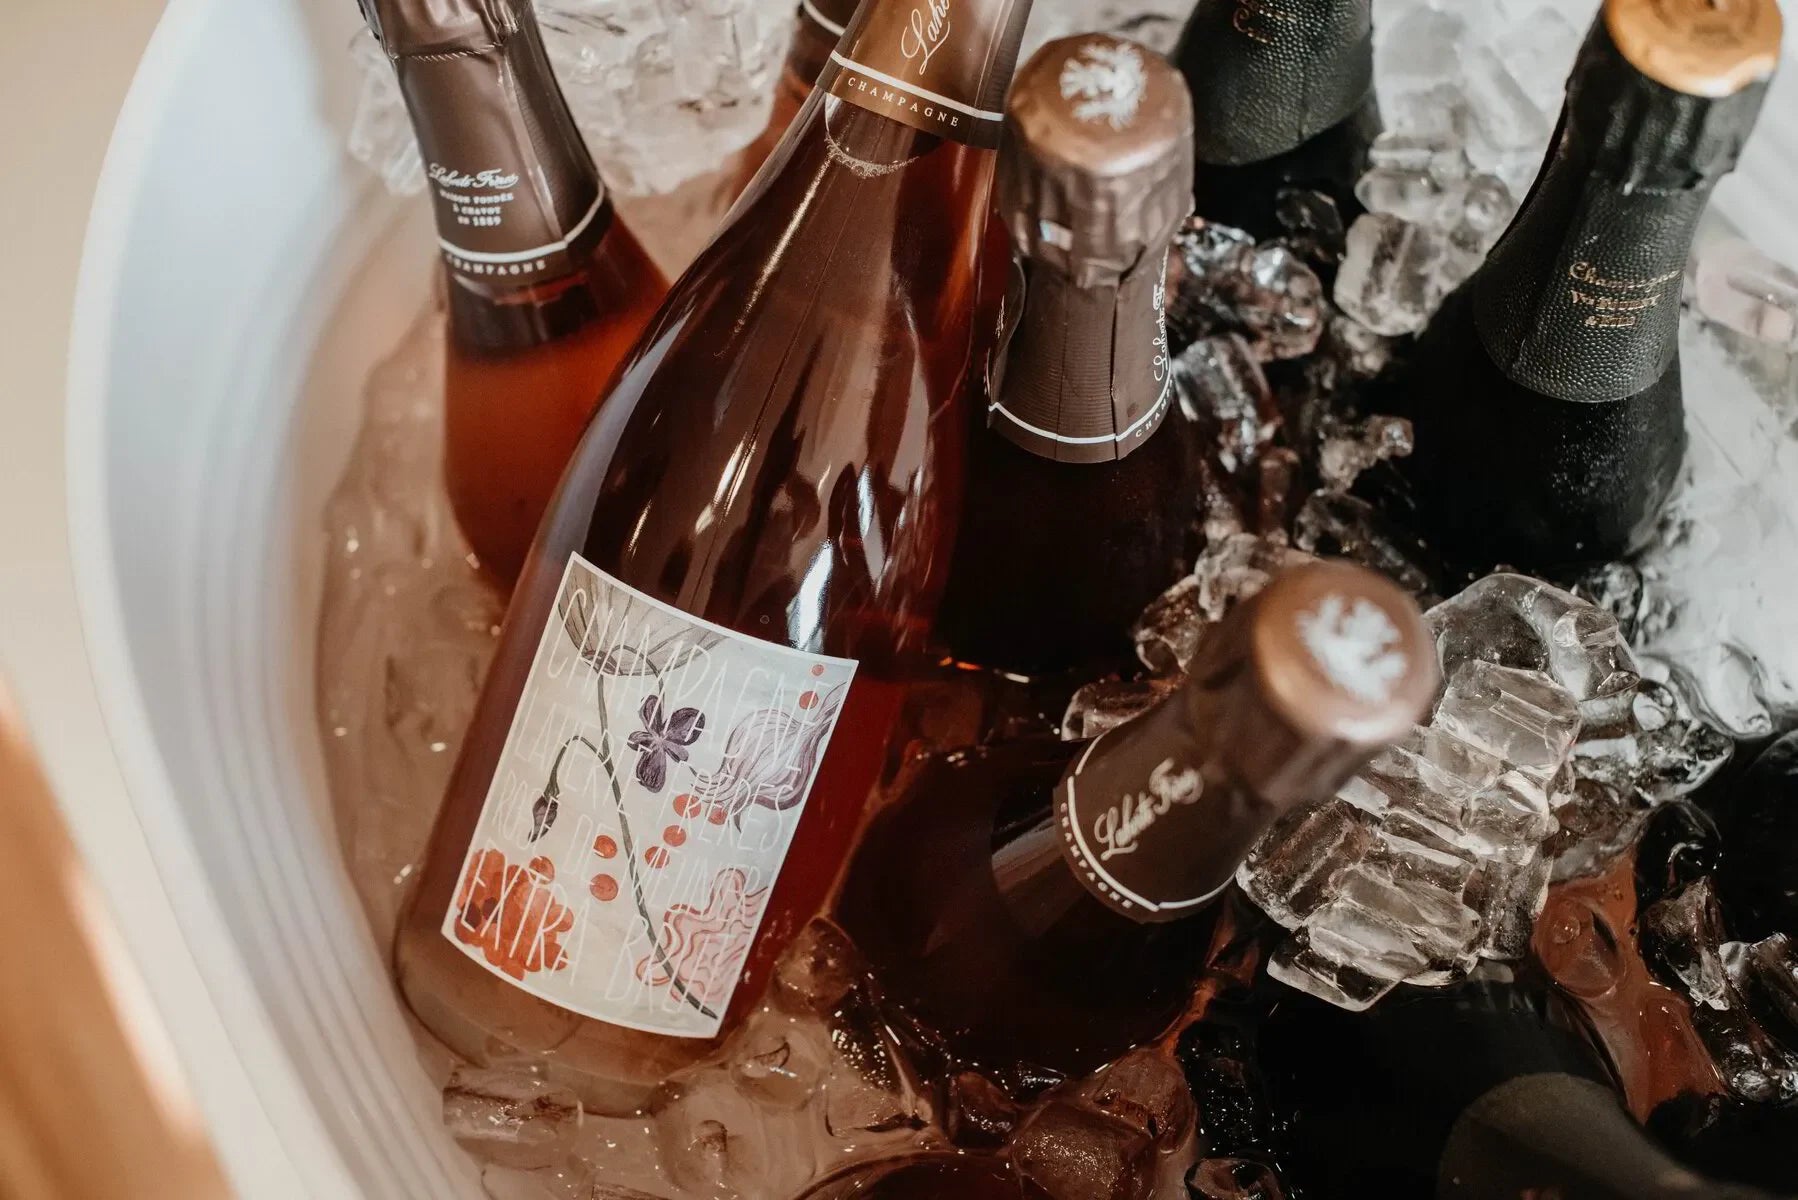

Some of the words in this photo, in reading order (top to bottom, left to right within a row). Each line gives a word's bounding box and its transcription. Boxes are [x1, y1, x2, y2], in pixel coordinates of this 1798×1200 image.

[848, 77, 959, 127] CHAMPAGNE
[547, 587, 833, 772] CHAMPAGNE
[563, 814, 616, 886] DE
[459, 838, 590, 987] EXTRA
[604, 913, 736, 1013] BRUT
